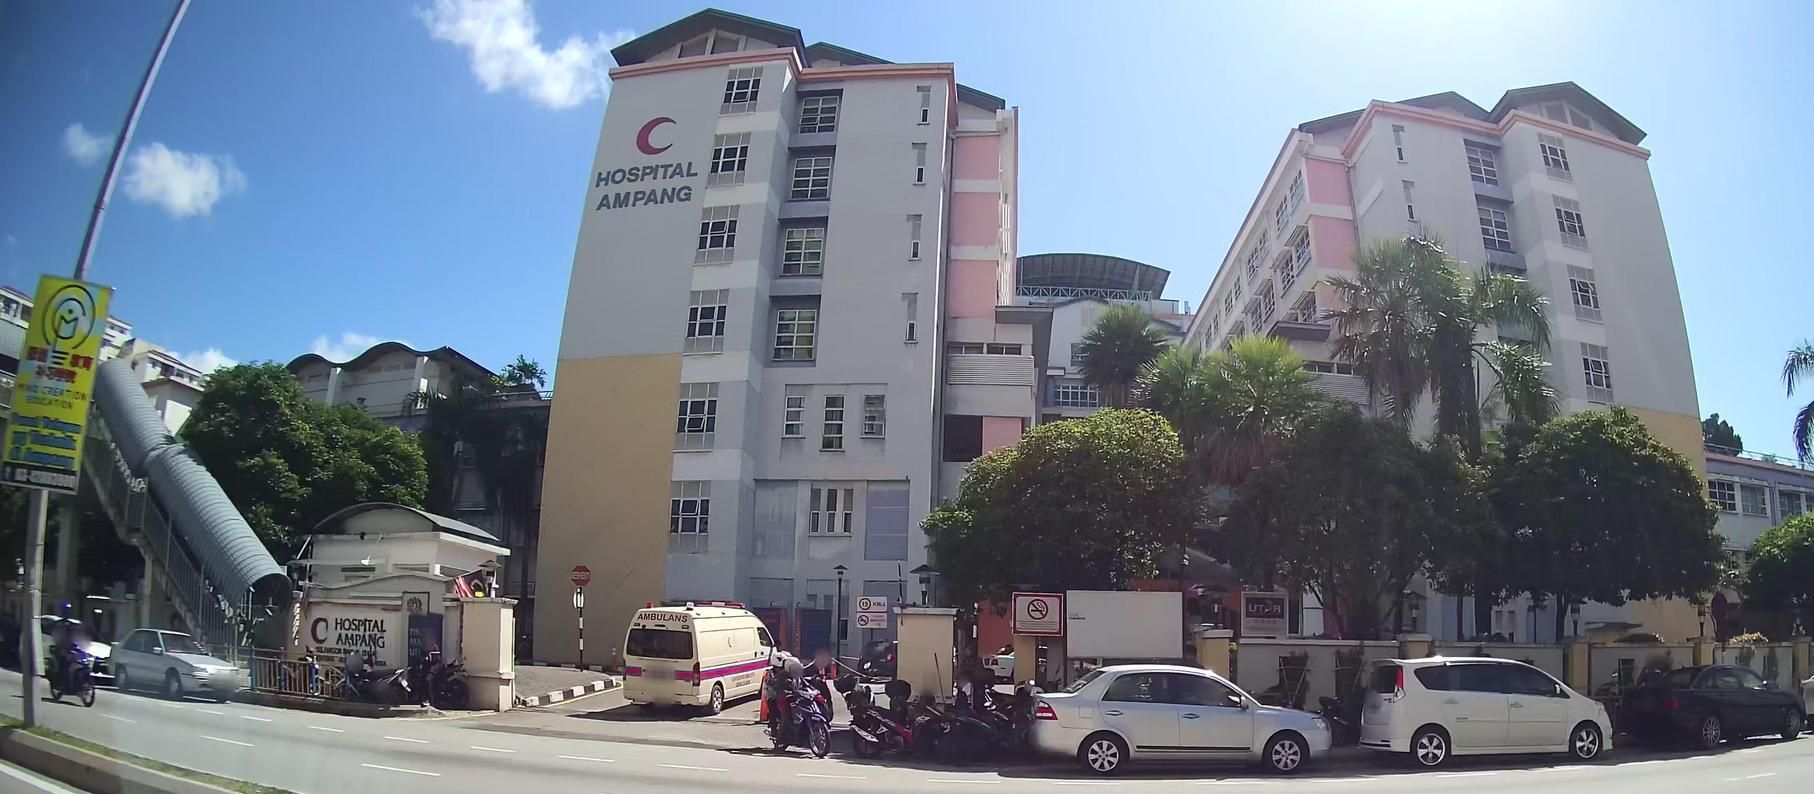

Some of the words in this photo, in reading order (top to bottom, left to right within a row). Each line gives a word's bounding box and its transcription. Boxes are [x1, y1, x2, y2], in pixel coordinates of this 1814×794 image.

[595, 162, 698, 188] HOSPITAL
[596, 186, 693, 211] AMPANG
[335, 617, 386, 633] HOSPITAL
[637, 613, 688, 623] AMBULANS
[336, 633, 386, 648] AMPANG
